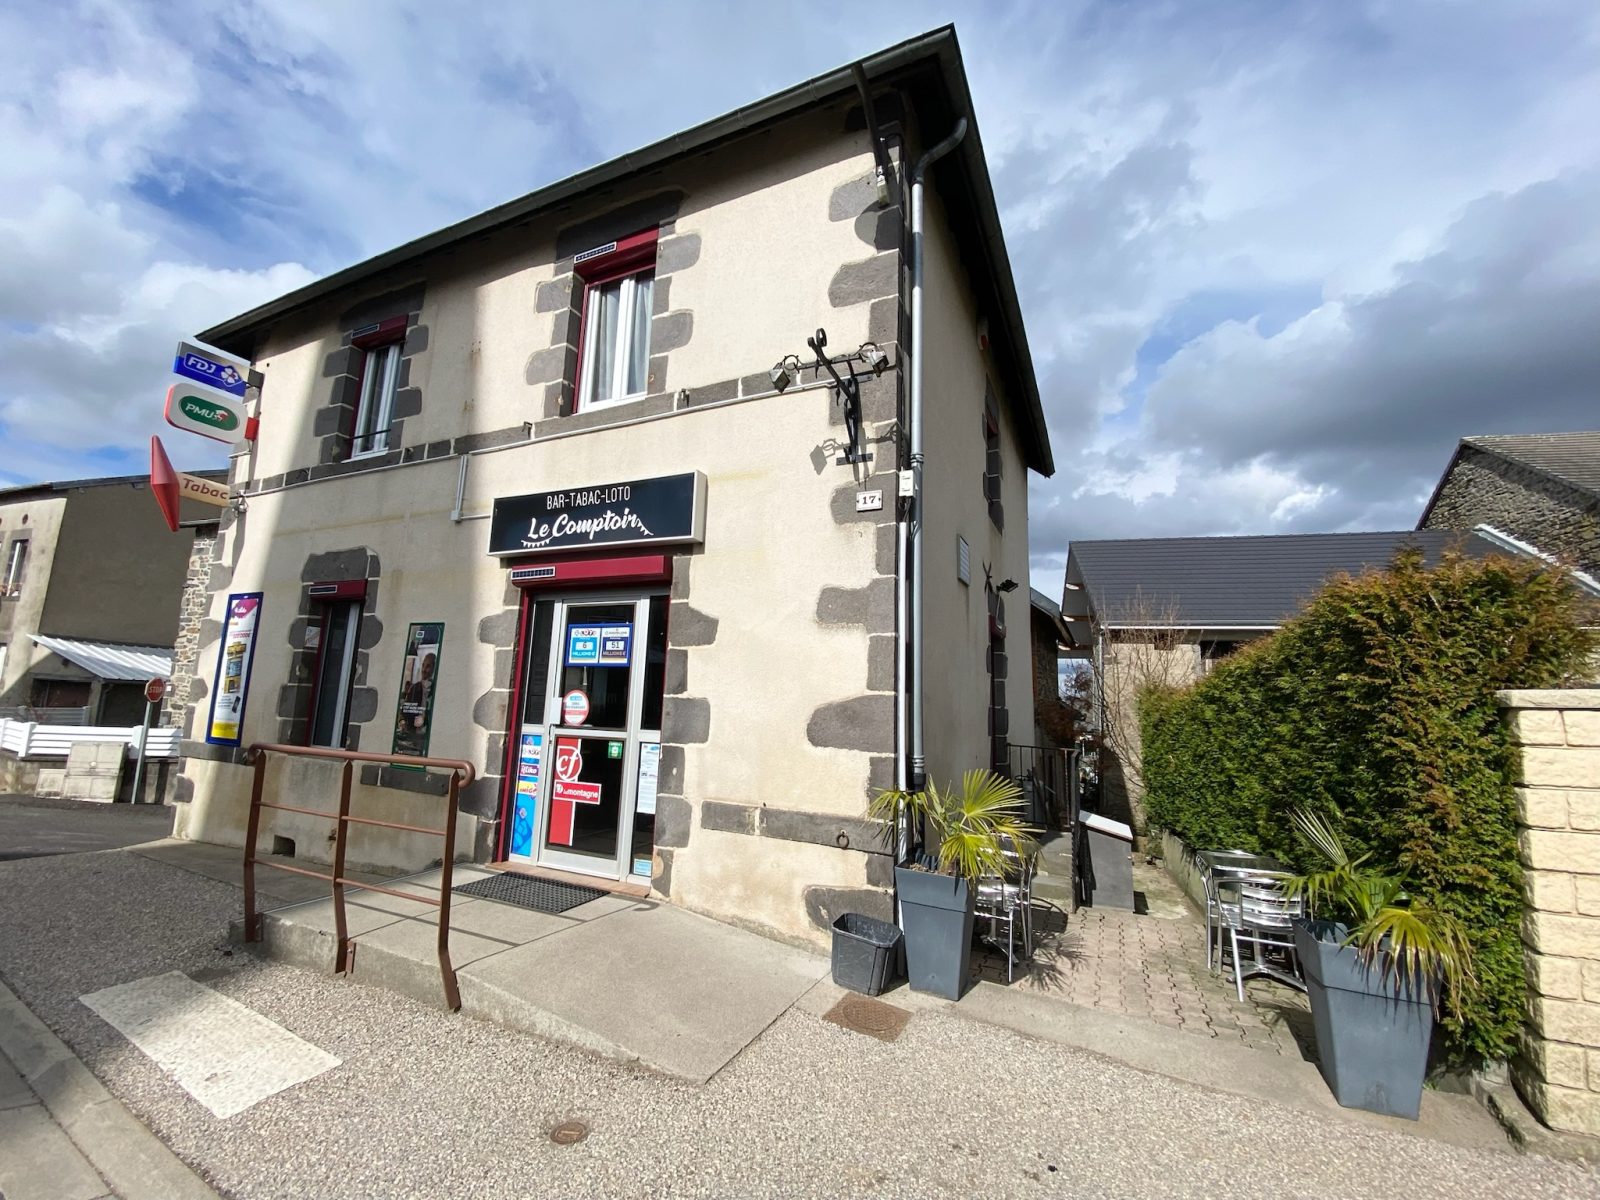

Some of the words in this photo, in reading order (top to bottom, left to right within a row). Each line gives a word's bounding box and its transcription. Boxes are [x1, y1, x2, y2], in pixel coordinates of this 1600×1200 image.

[187, 357, 216, 374] FDJ
[185, 402, 214, 419] PMU
[183, 477, 229, 500] Tabac
[546, 485, 631, 510] BAR-TABAC-LOTO
[862, 495, 877, 505] 17
[527, 517, 550, 539] Le
[551, 507, 638, 540] Comptoir
